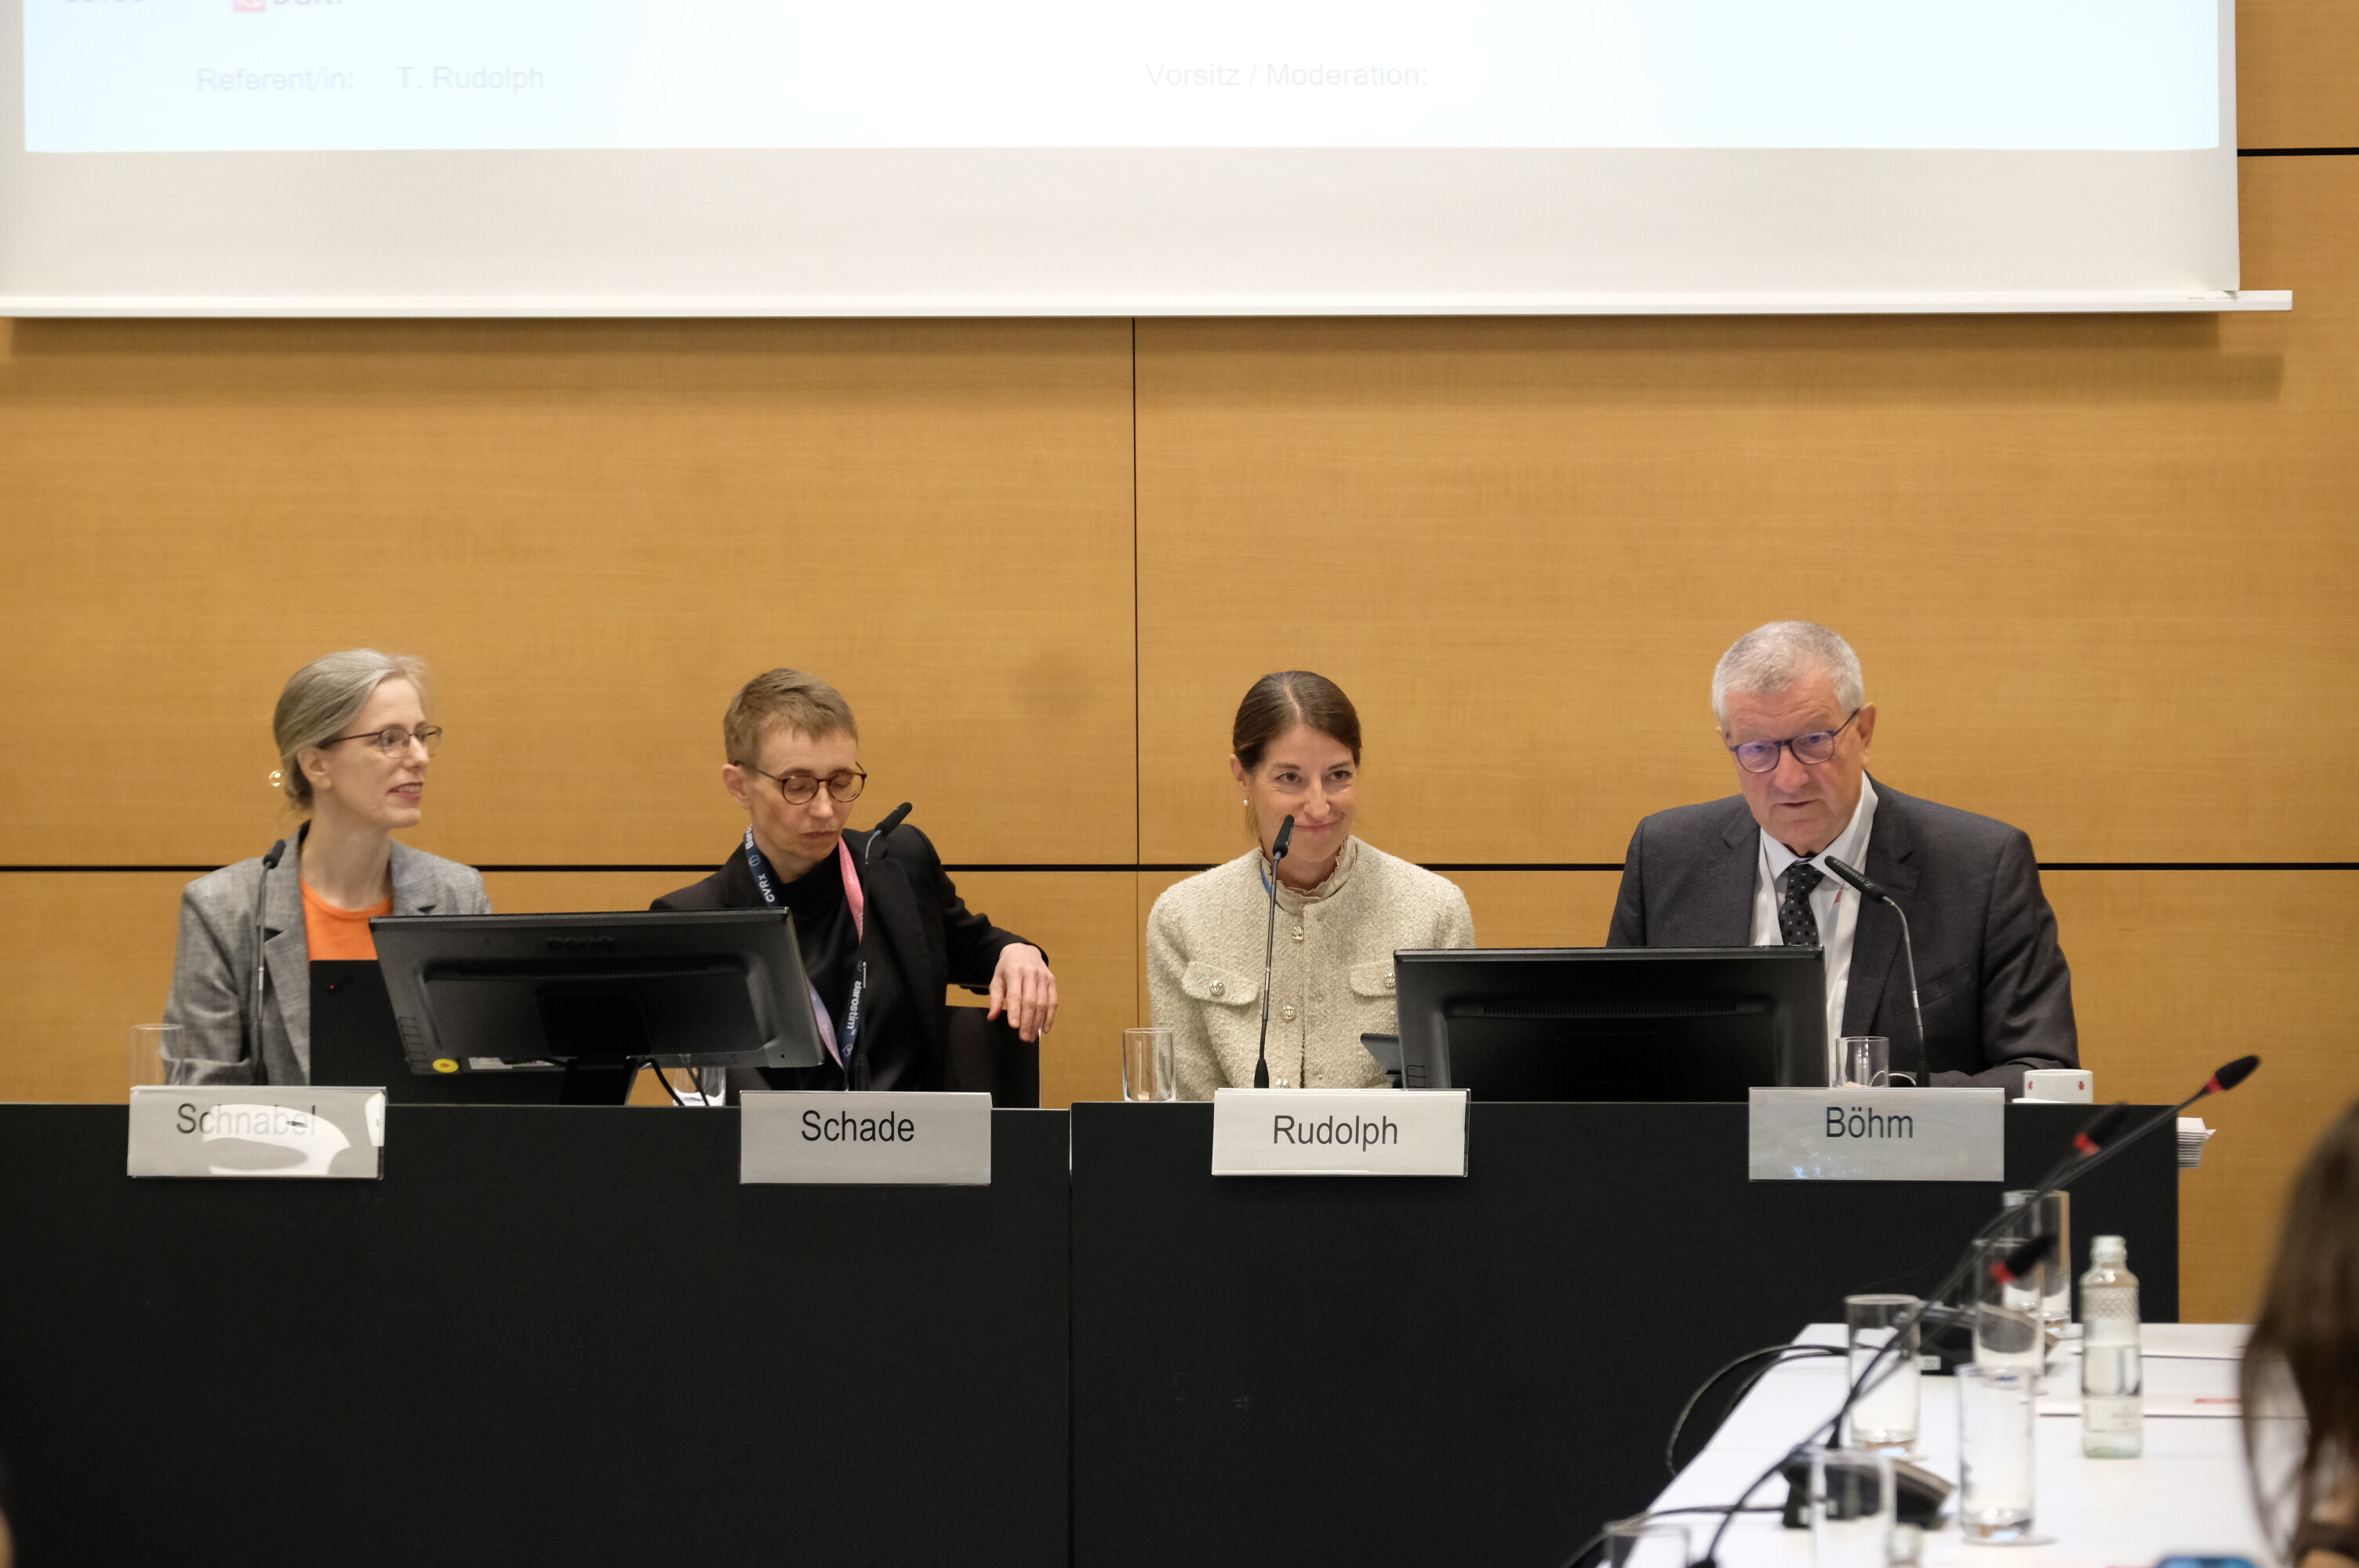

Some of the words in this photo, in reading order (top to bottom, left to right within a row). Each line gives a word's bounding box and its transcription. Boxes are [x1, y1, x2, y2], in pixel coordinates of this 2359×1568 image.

[197, 67, 354, 90] Referent/in:
[397, 67, 423, 89] T.
[433, 66, 544, 93] Rudolph
[1146, 63, 1241, 85] Vorsitz
[1249, 63, 1259, 85] /
[1267, 63, 1427, 85] Moderation:
[176, 1103, 315, 1135] Schnabel
[801, 1110, 914, 1142] Schade
[1274, 1115, 1398, 1152] Rudolph
[1826, 1107, 1914, 1138] Böhm
